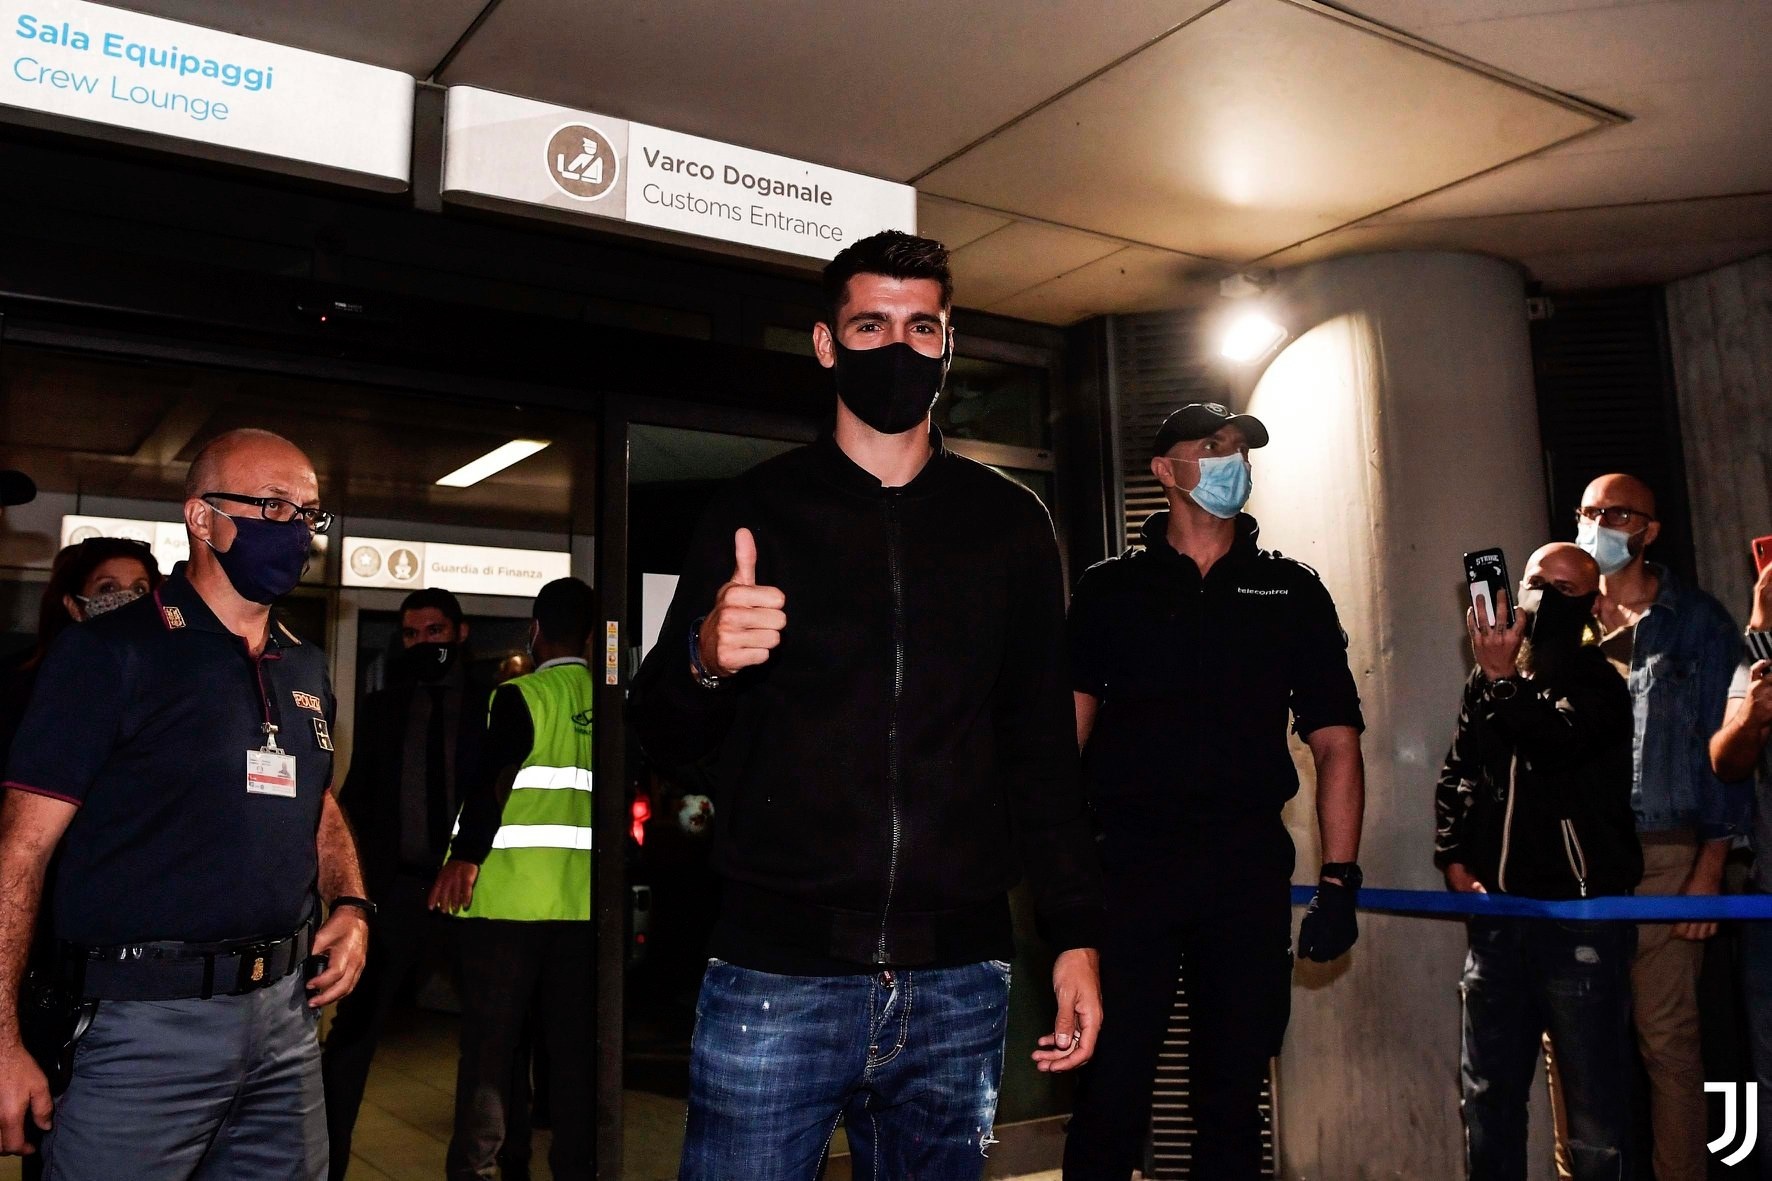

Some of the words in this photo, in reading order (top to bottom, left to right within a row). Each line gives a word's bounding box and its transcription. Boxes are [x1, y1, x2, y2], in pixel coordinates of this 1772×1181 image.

[16, 14, 90, 51] Sala
[103, 32, 273, 91] Equipaggi
[13, 57, 99, 94] Crew
[111, 76, 229, 121] Lounge
[642, 146, 715, 180] Varco
[723, 165, 833, 206] Doganale
[642, 183, 742, 221] Customs
[750, 205, 844, 242] Entrance
[431, 561, 479, 576] Guardia
[482, 565, 494, 576] di
[498, 566, 543, 579] Finanza
[1237, 587, 1289, 596] telecontrol
